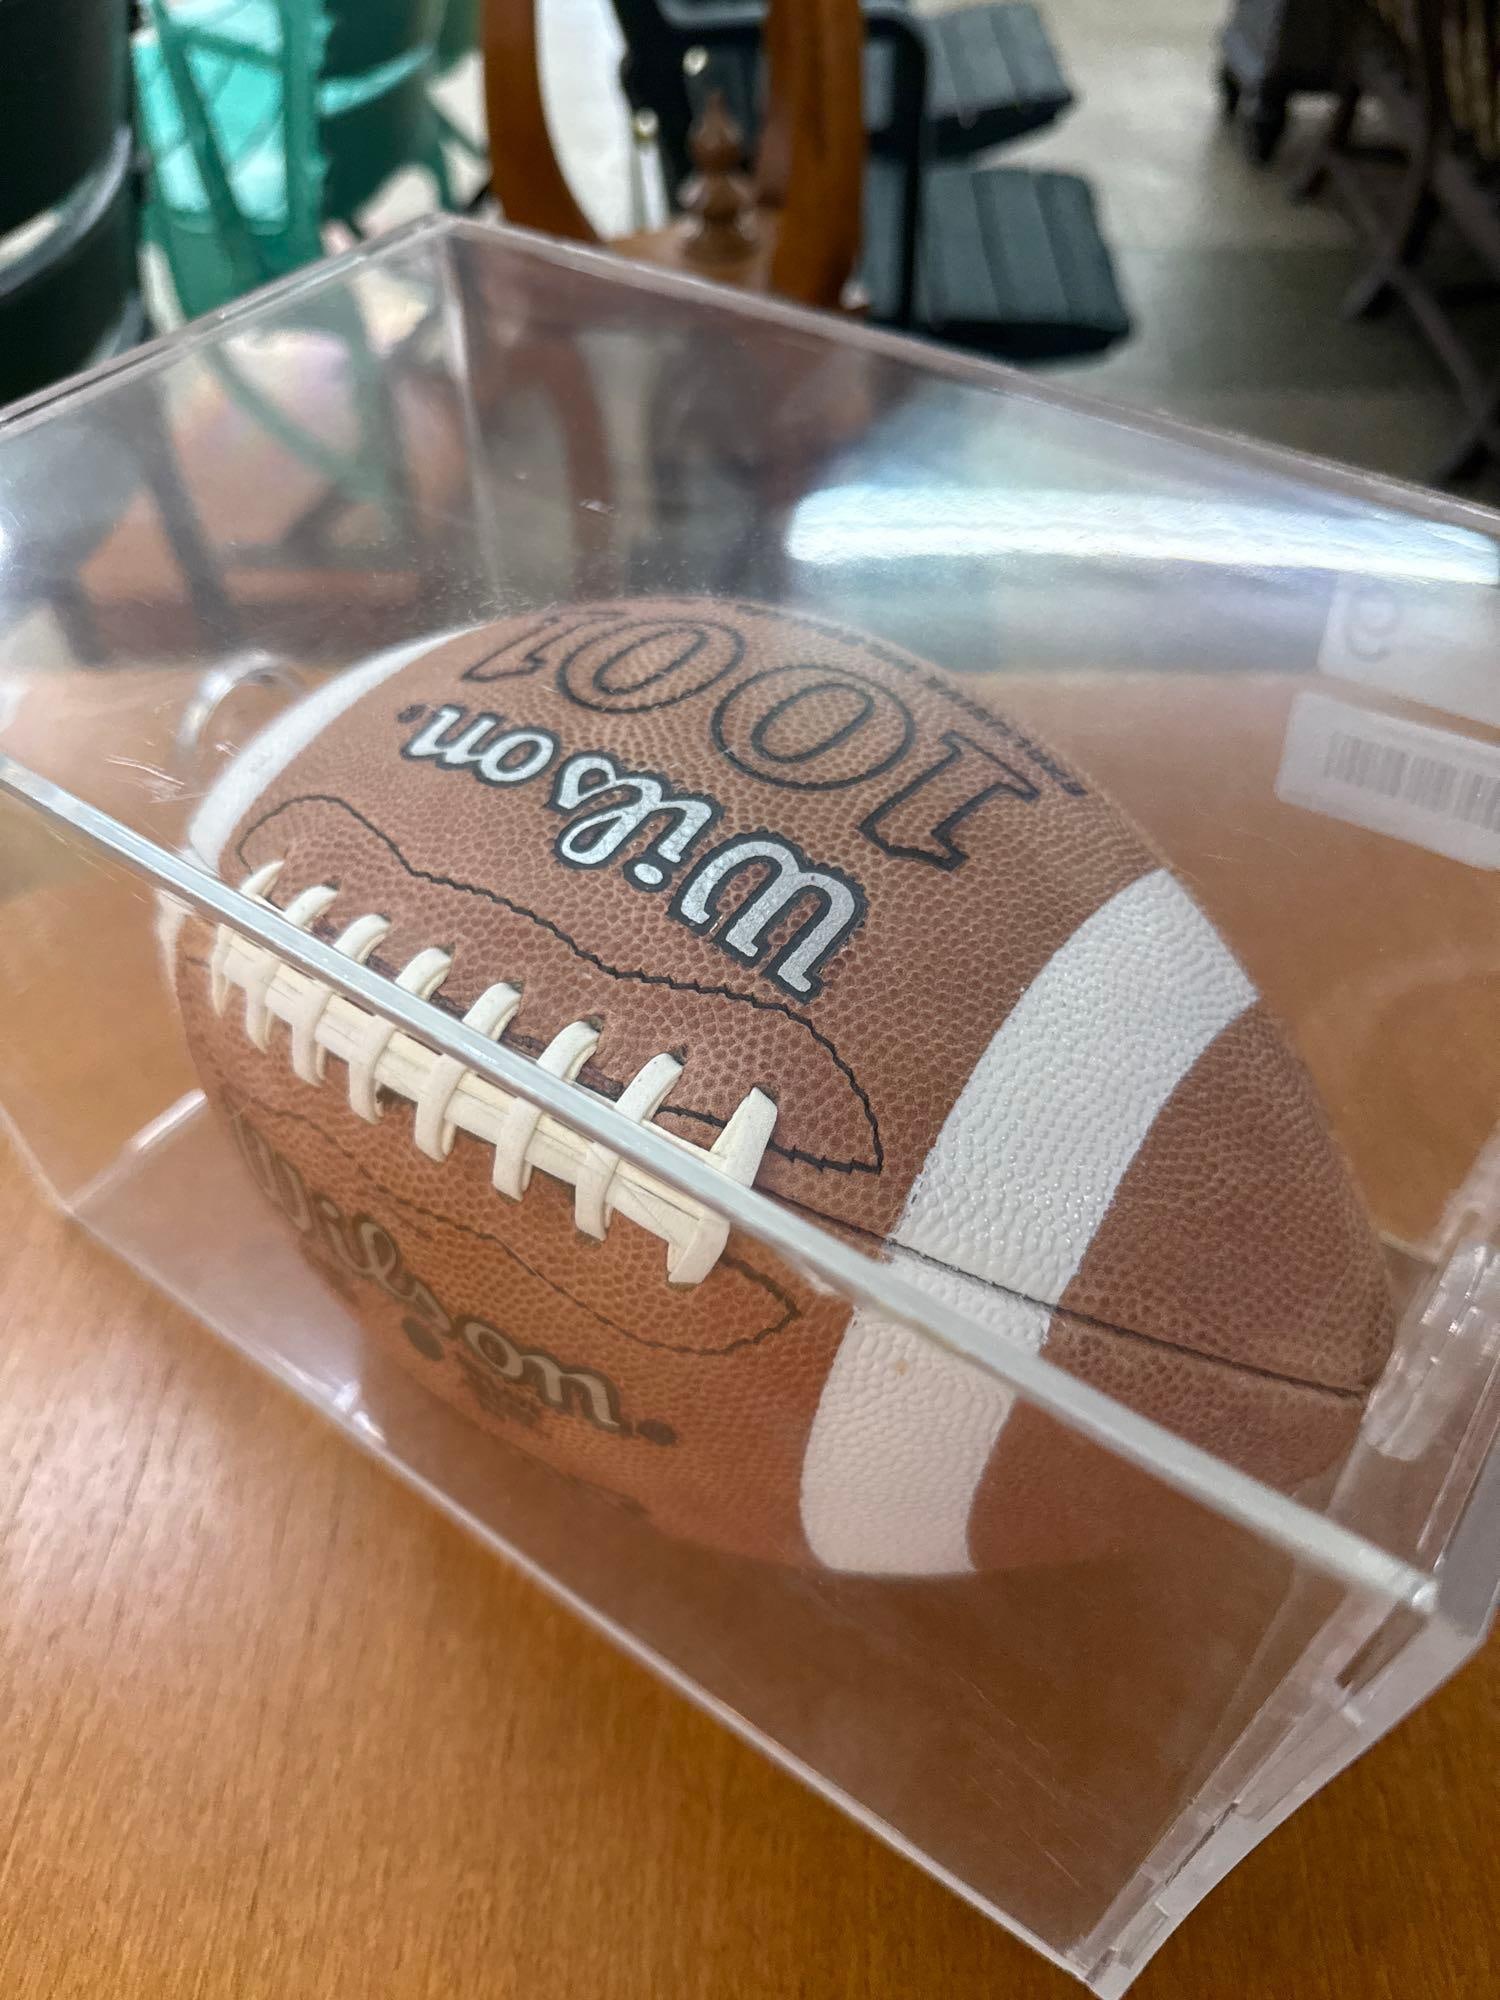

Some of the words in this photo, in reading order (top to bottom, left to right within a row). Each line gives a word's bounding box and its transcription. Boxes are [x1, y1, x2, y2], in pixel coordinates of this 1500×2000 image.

[402, 704, 868, 998] Wilson
[462, 610, 1041, 873] 1001
[229, 1096, 634, 1432] Wilson
